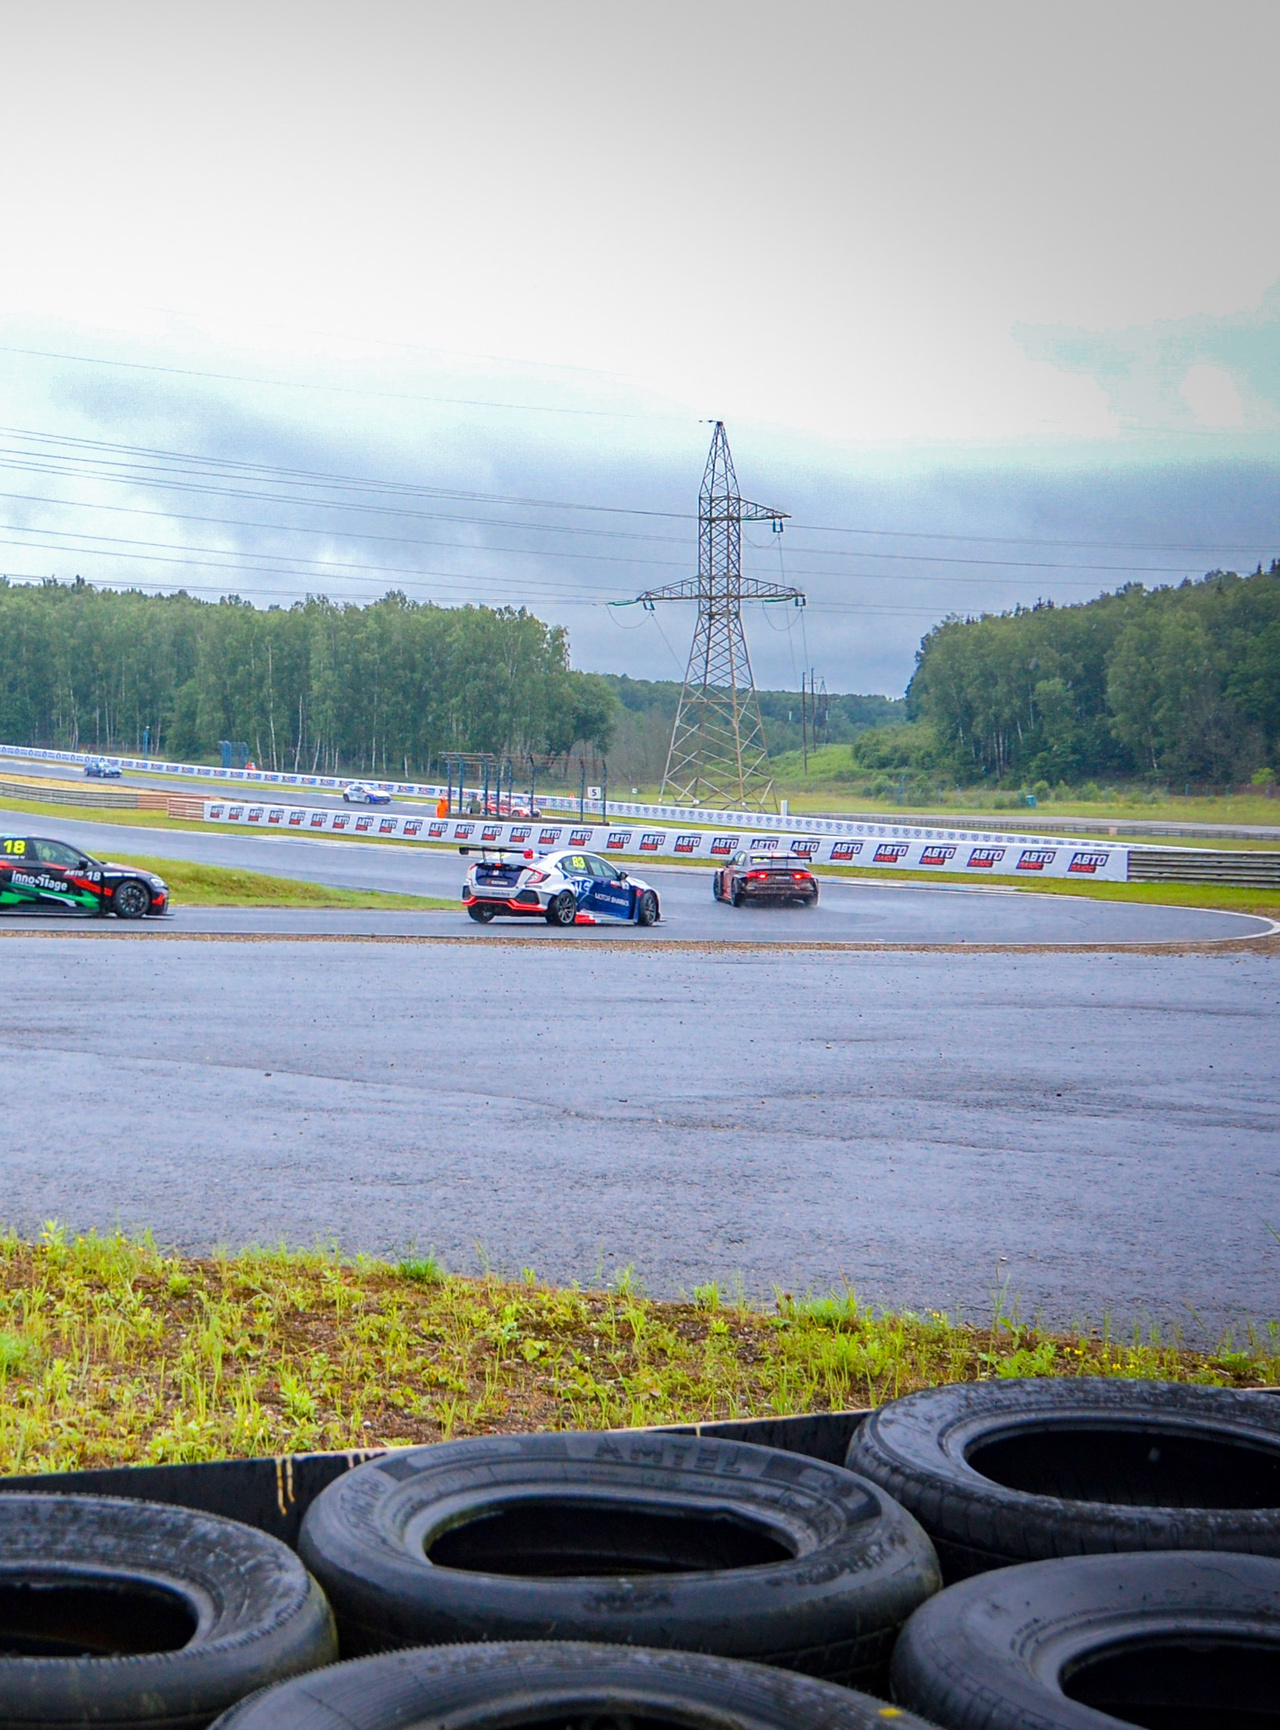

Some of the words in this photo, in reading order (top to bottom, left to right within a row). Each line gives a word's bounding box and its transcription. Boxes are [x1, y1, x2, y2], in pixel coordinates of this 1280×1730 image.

[405, 822, 421, 830] АВТО
[456, 825, 473, 833] АВТО
[483, 827, 501, 835] АВТО
[511, 828, 530, 836] АВТО
[541, 830, 560, 838] АВТО
[571, 831, 591, 839] АВТО
[608, 834, 629, 843] АВТО
[642, 835, 663, 844] АВТО
[677, 837, 699, 846] АВТО
[3, 840, 26, 854] 18
[713, 839, 737, 848] АВТО
[752, 840, 777, 850] АВТО
[792, 842, 817, 851] АВТО
[833, 843, 860, 853] АВТО
[878, 845, 906, 855] АВТО
[924, 847, 954, 858] АВТО
[972, 849, 1003, 860] АВТО
[1022, 851, 1053, 862] АВТО
[1073, 854, 1106, 865] АВТО
[572, 856, 586, 868] 83
[86, 871, 102, 881] 18
